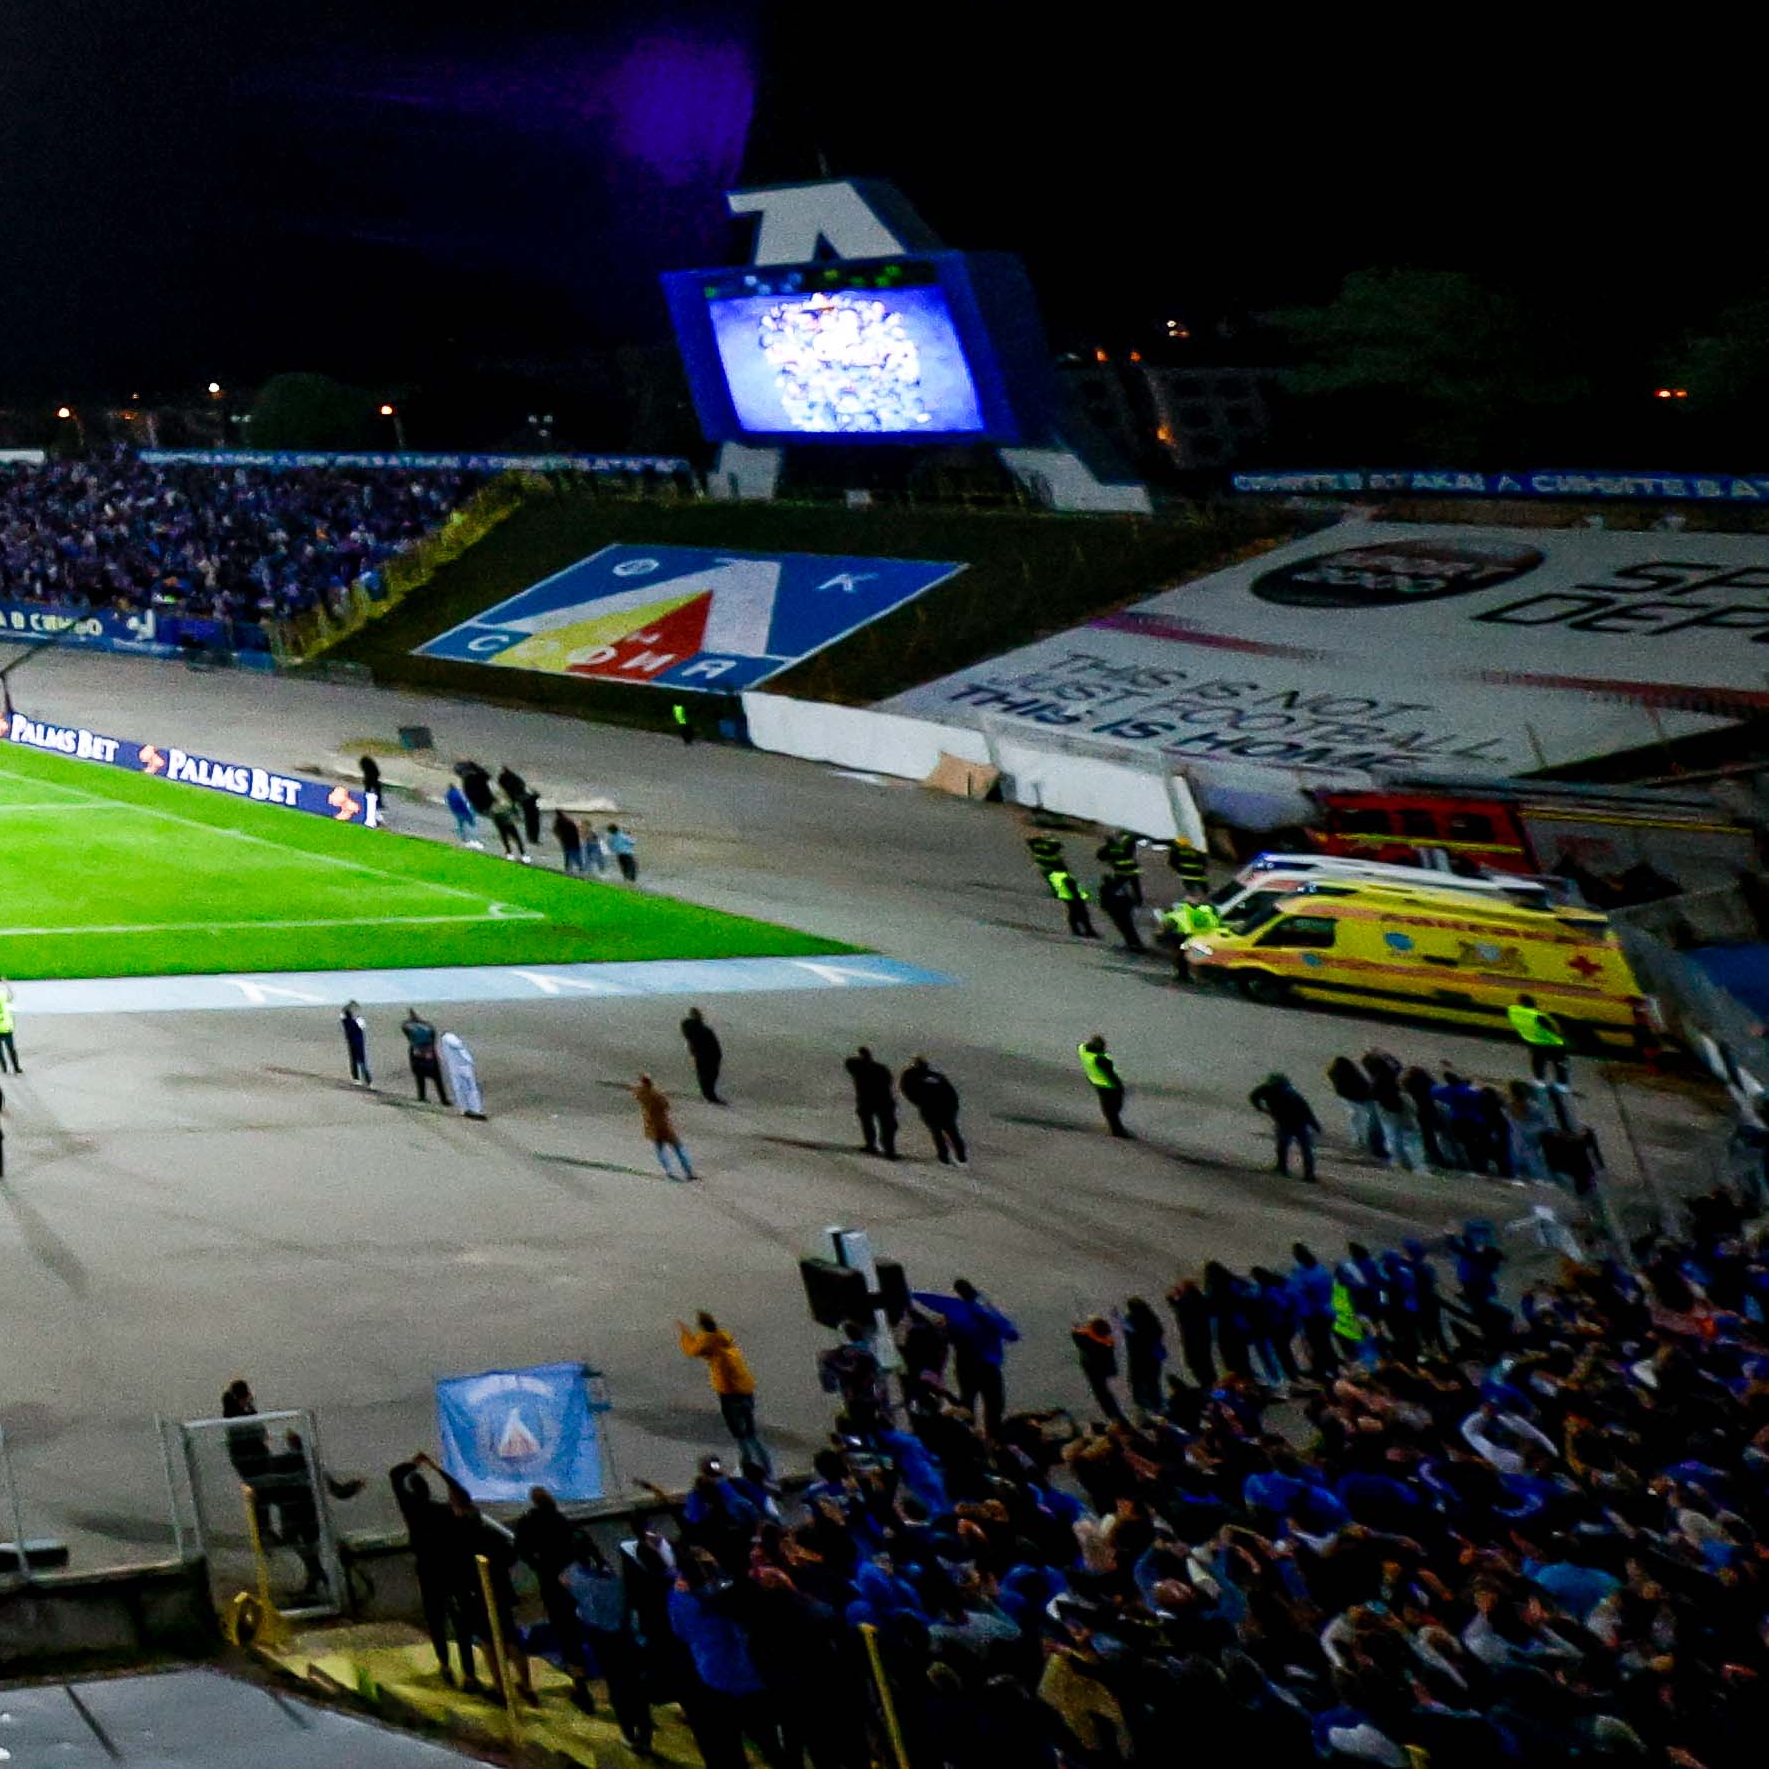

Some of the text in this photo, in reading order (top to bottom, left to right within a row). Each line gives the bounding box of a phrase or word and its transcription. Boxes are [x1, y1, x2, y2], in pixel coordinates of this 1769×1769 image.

[10, 712, 120, 763] PALMS BET
[166, 748, 302, 806] PALMS BET
